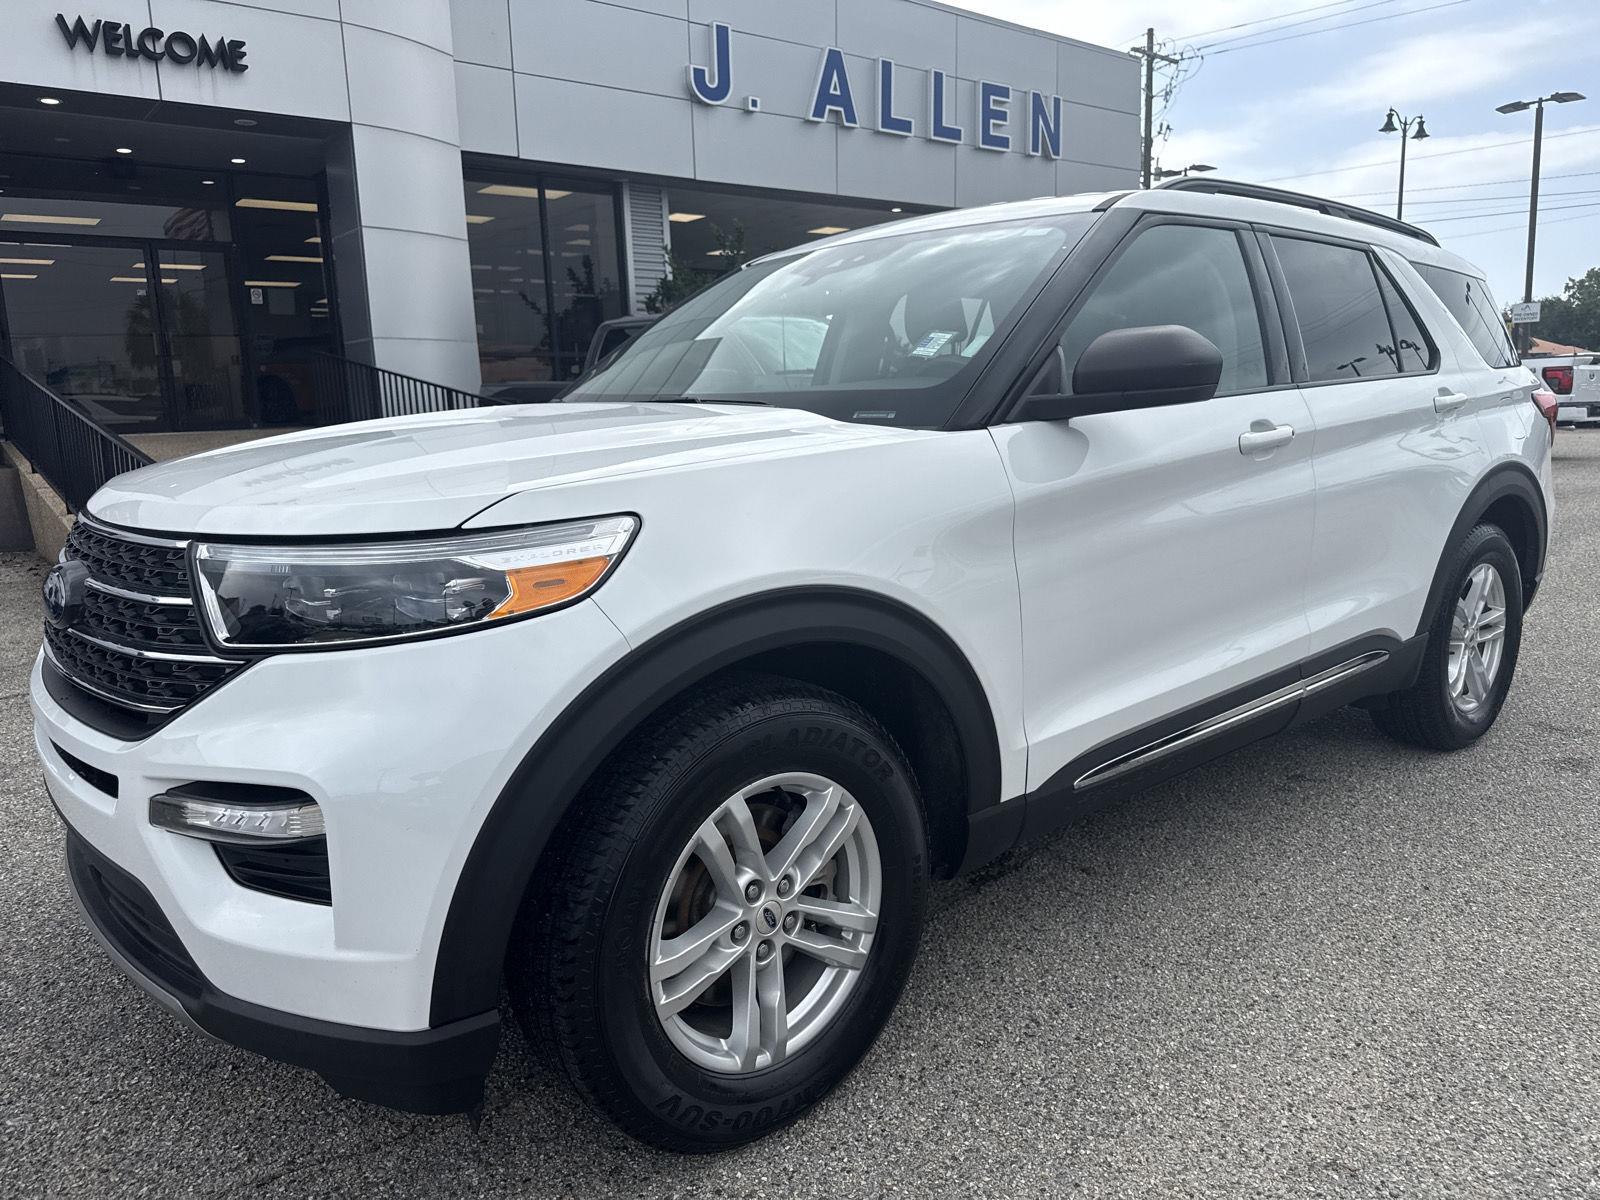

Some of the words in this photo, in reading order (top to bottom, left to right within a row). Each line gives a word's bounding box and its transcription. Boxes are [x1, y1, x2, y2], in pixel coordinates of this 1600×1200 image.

[55, 13, 249, 73] WELCOME
[687, 21, 760, 111] J.
[806, 46, 1062, 159] ALLEN
